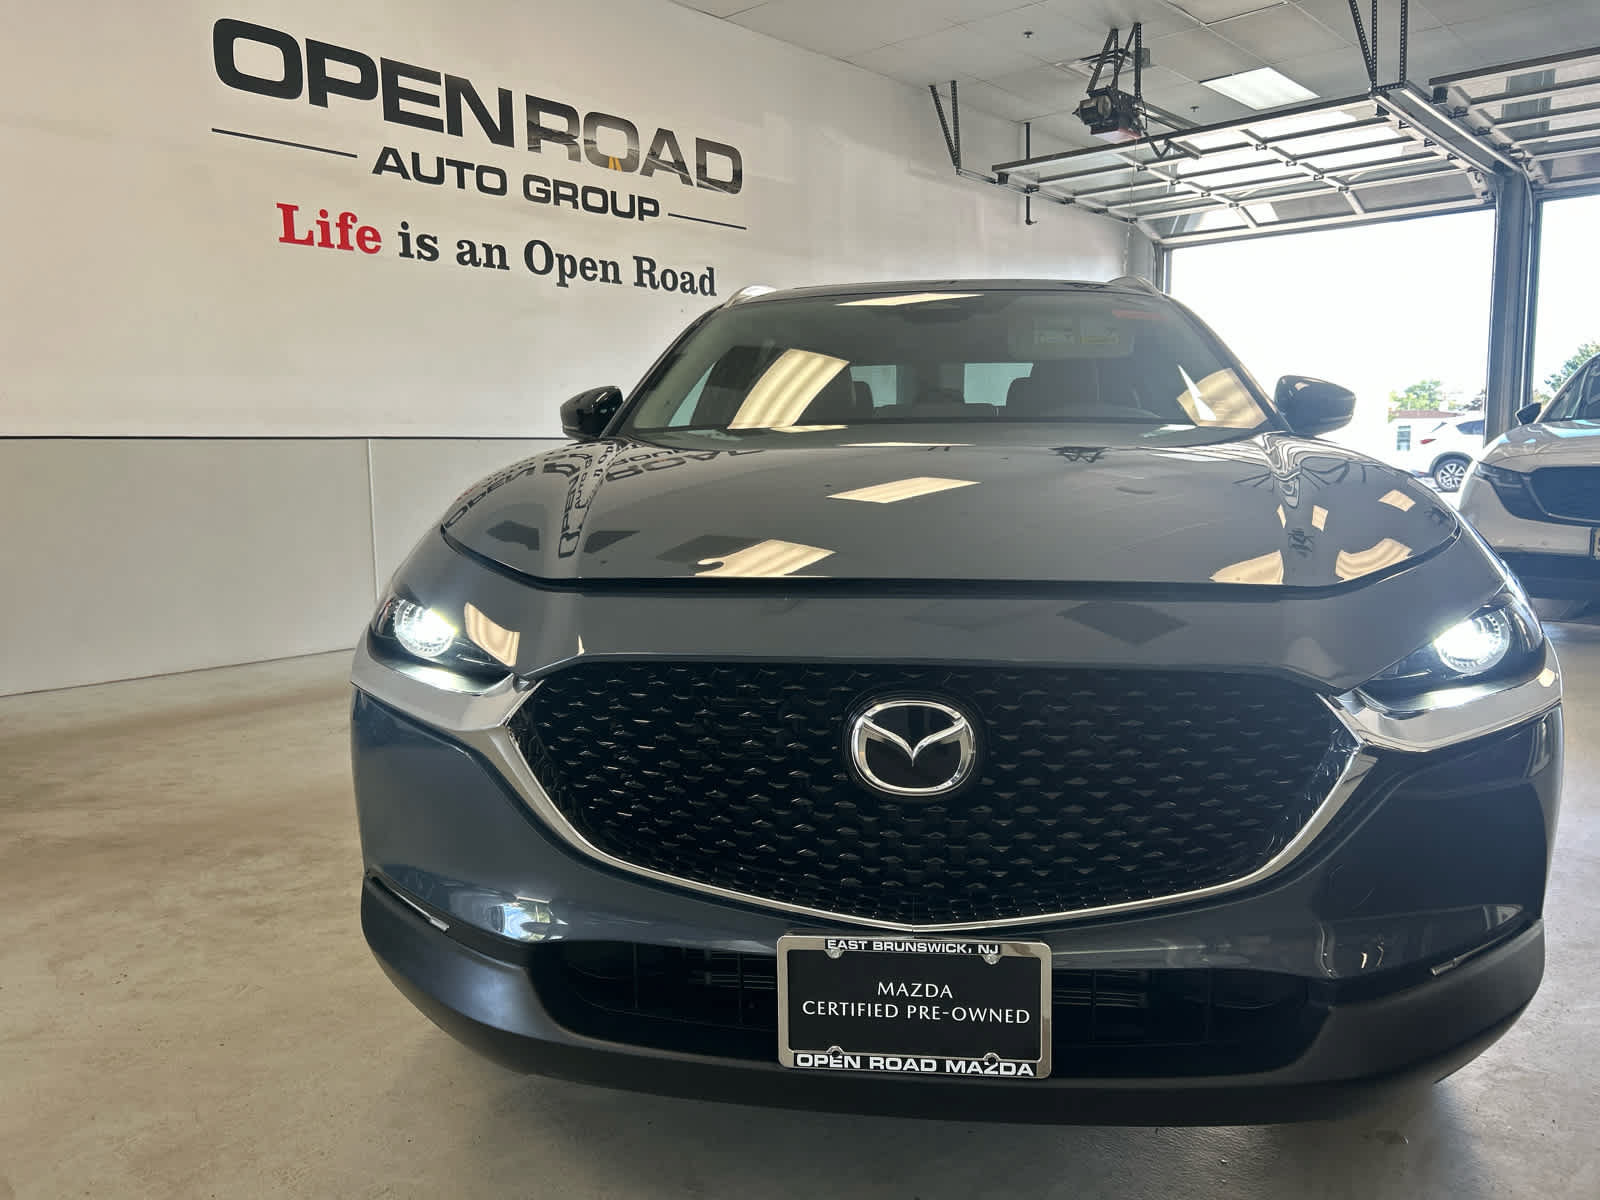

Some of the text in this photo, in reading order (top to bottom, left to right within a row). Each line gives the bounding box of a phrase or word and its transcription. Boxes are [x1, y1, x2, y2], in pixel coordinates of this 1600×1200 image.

[372, 146, 660, 222] AUTO GROUP
[276, 203, 717, 297] Life is an Open Road
[827, 939, 999, 955] EAST BRUNSWICK, NJ
[877, 981, 953, 999] MAZDA
[802, 1000, 1030, 1024] CERTIFIED PRE-OWNED
[796, 1054, 1034, 1077] OPEN ROAD MAZDA
